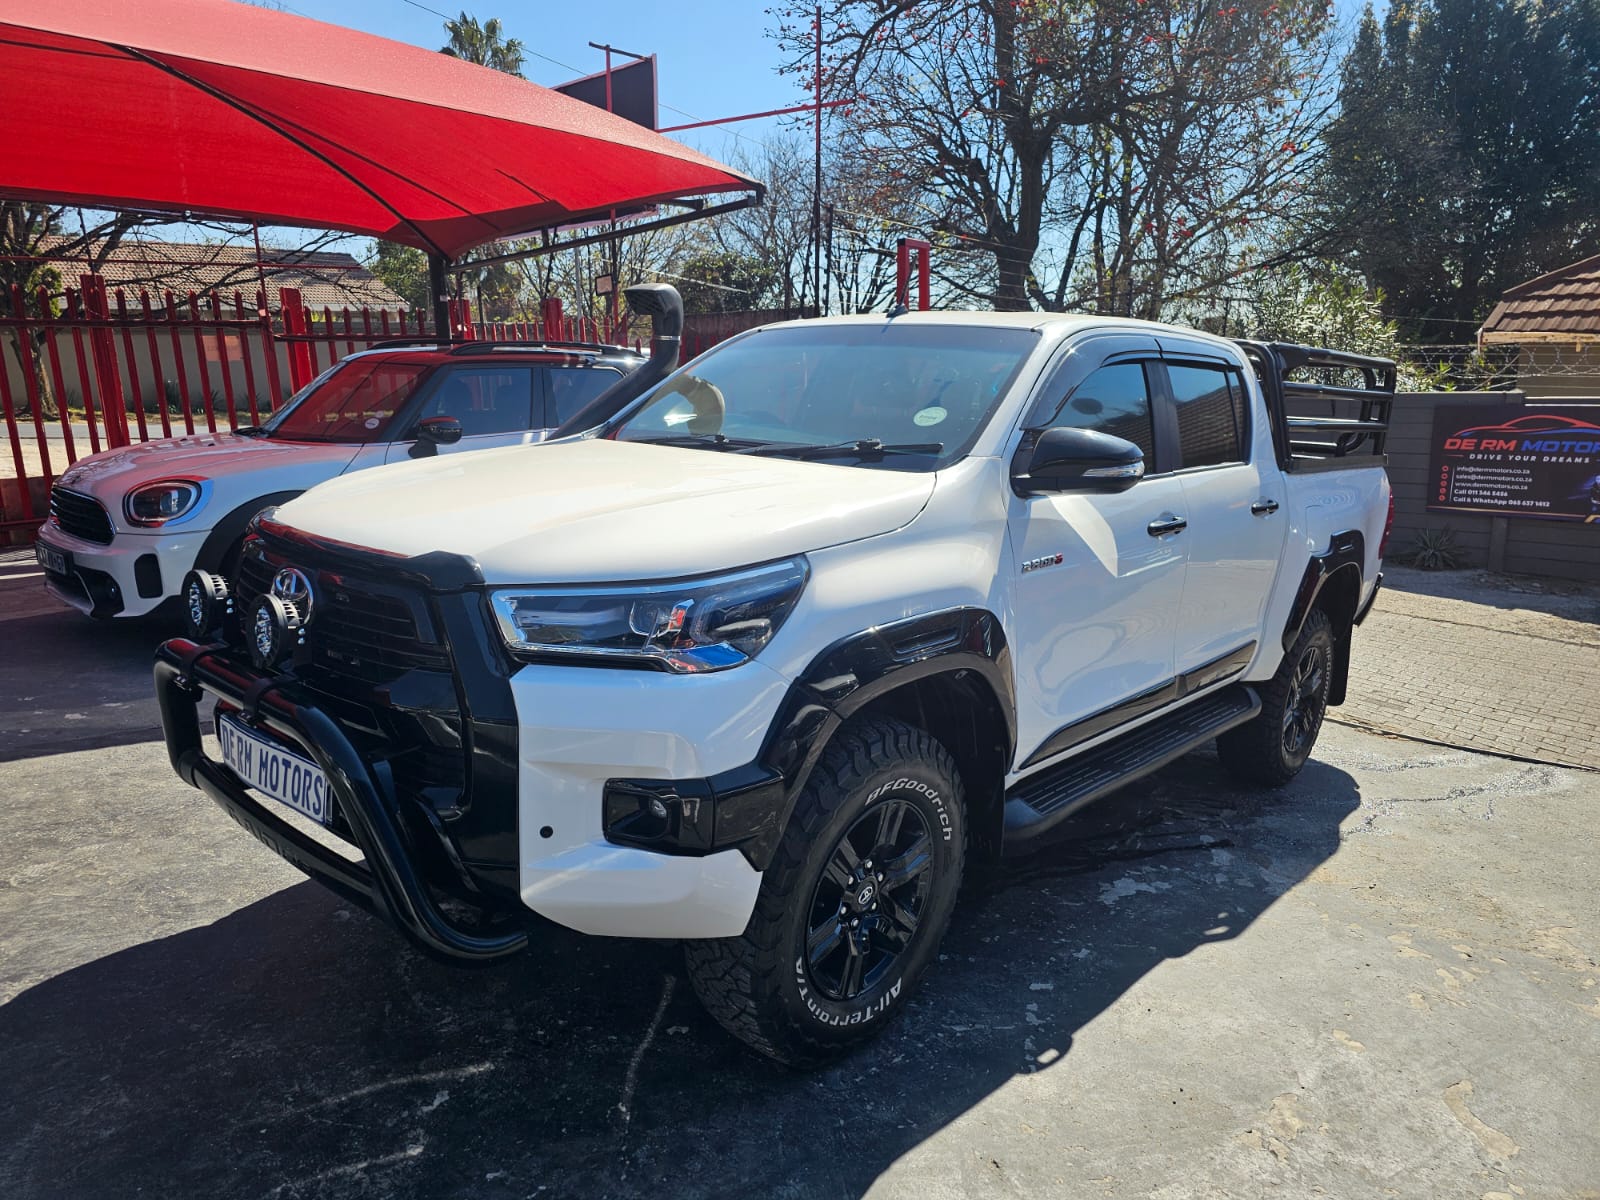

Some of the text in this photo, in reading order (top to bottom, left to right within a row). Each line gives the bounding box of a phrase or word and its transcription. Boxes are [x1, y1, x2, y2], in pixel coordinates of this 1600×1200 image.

[1444, 438, 1478, 450] DE
[1479, 439, 1518, 452] RM
[1469, 453, 1591, 464] DRIVE YOUR DREAMS
[1456, 466, 1530, 475] info@dermmotors.co.za
[1455, 473, 1533, 482] sales@dermmotors.co.za
[1454, 481, 1528, 490] www.dermmotors.co.za
[1472, 497, 1507, 506] WhatsApp
[258, 748, 323, 815] MOTORS
[864, 778, 953, 841] BFGoodrich
